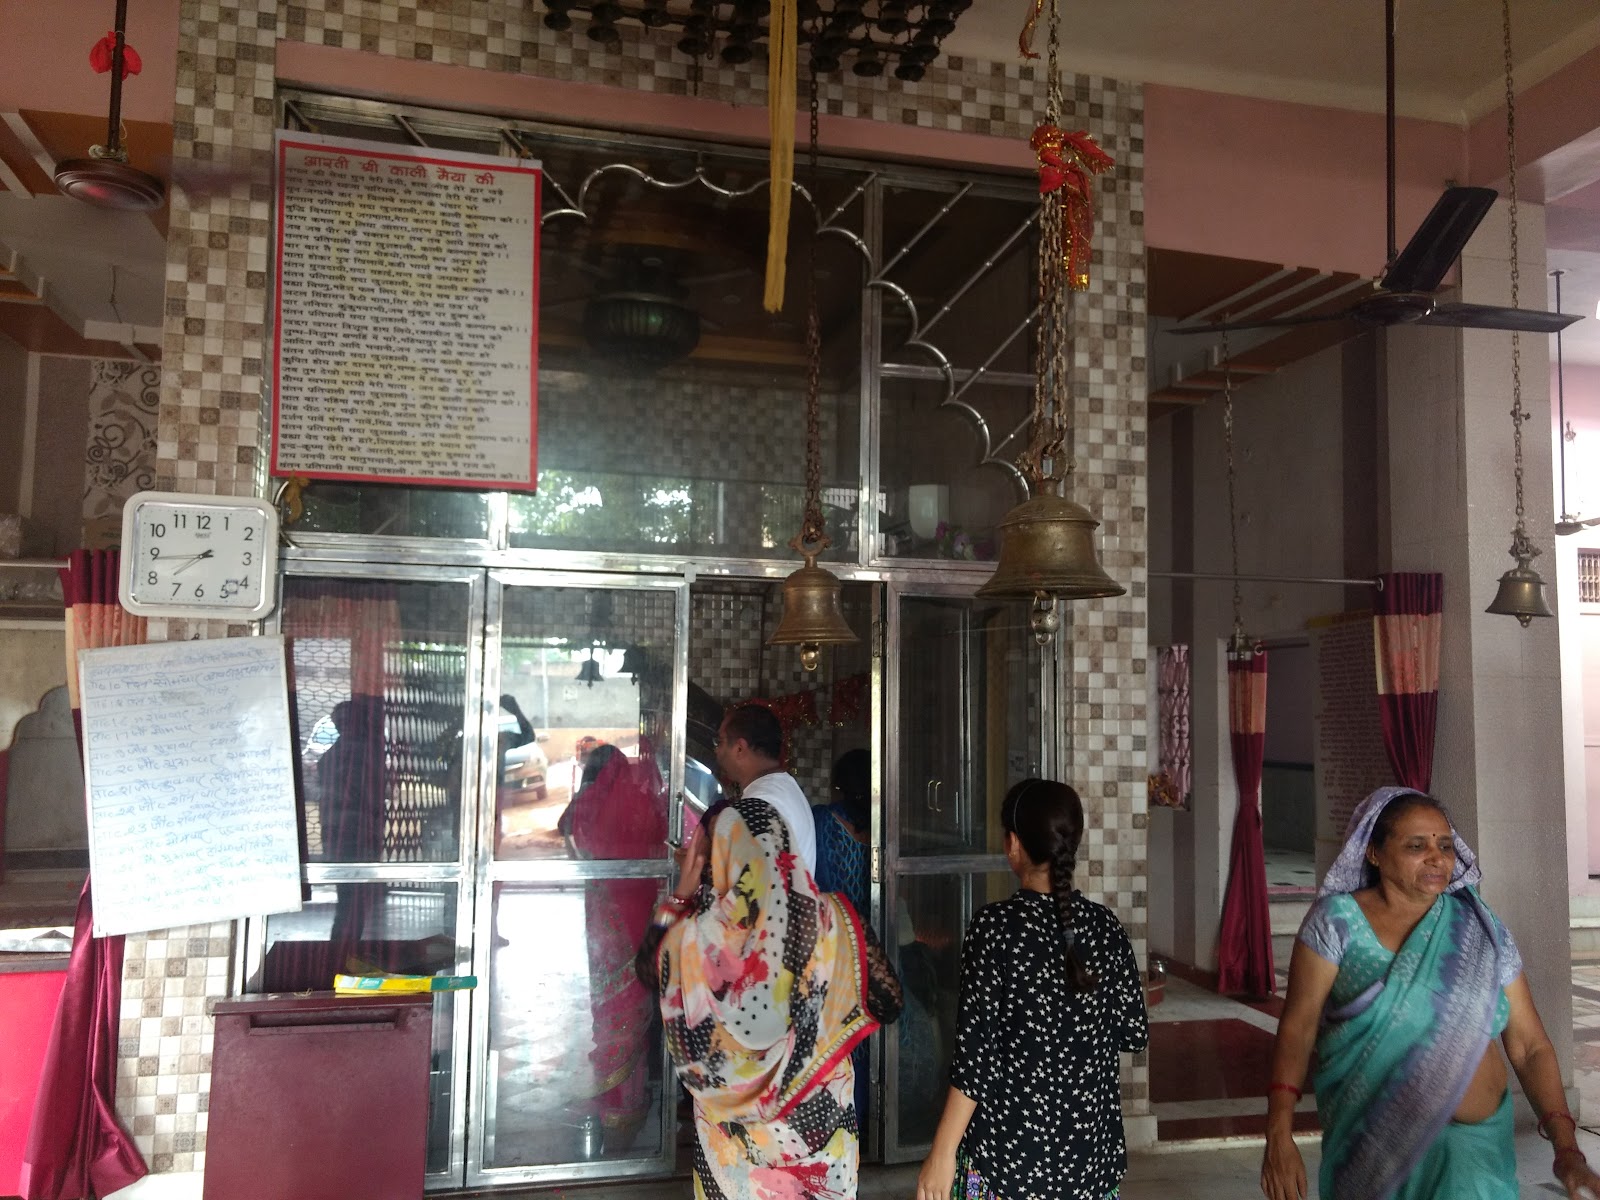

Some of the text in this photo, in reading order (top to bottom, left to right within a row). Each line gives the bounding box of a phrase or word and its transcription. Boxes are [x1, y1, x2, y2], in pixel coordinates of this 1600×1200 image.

[304, 156, 496, 185] आरती श्री काली मैया की
[174, 514, 186, 528] 11
[196, 515, 211, 530] 12
[224, 517, 229, 530] 1
[150, 523, 166, 538] 10
[244, 527, 253, 541] 2
[150, 547, 160, 561] 9
[243, 552, 252, 566] 3
[148, 571, 158, 585] 8
[239, 576, 249, 589] 4
[172, 583, 182, 597] 7
[194, 584, 204, 598] 6
[219, 585, 229, 599] 5
